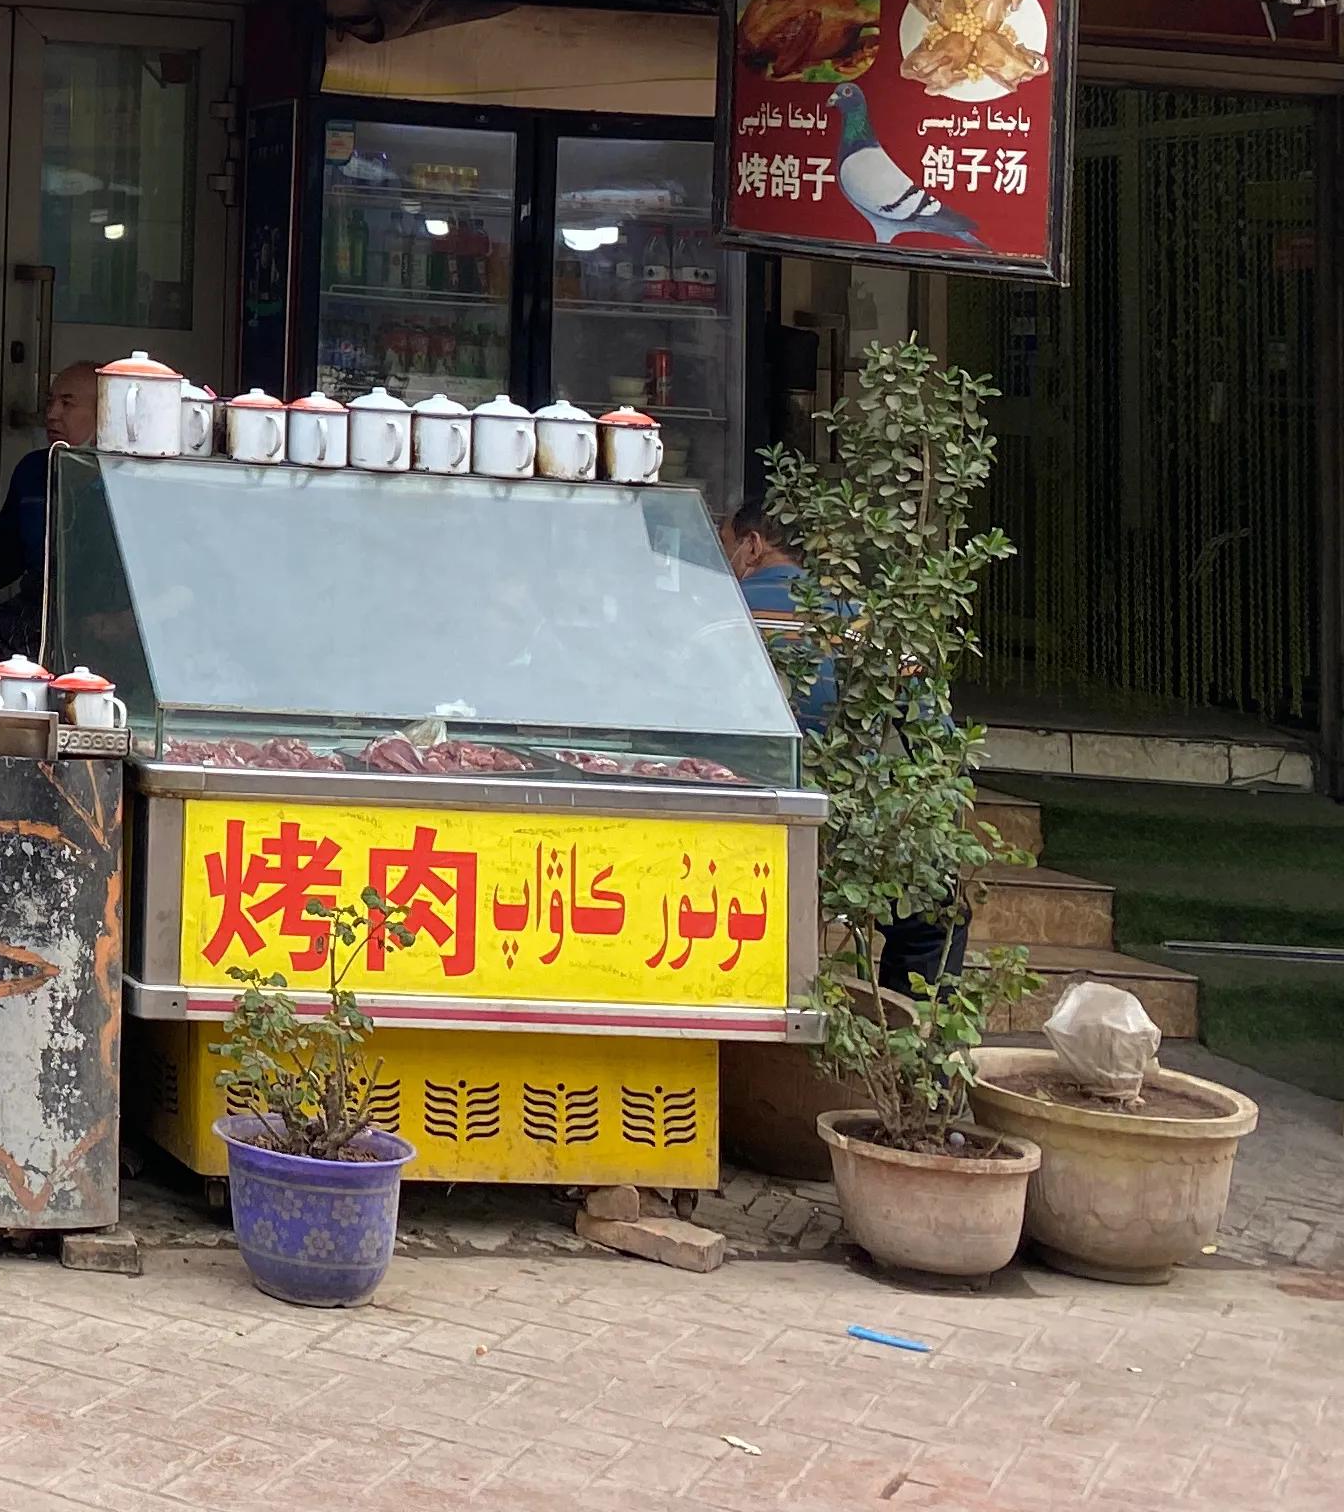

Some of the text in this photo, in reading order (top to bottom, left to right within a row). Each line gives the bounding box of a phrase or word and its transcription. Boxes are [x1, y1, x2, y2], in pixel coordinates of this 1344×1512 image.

[736, 151, 836, 202] 烤鸽子
[920, 144, 1028, 195] 鸽子汤
[201, 819, 478, 977] 烤肉
[492, 840, 626, 971] كاۋاپ
